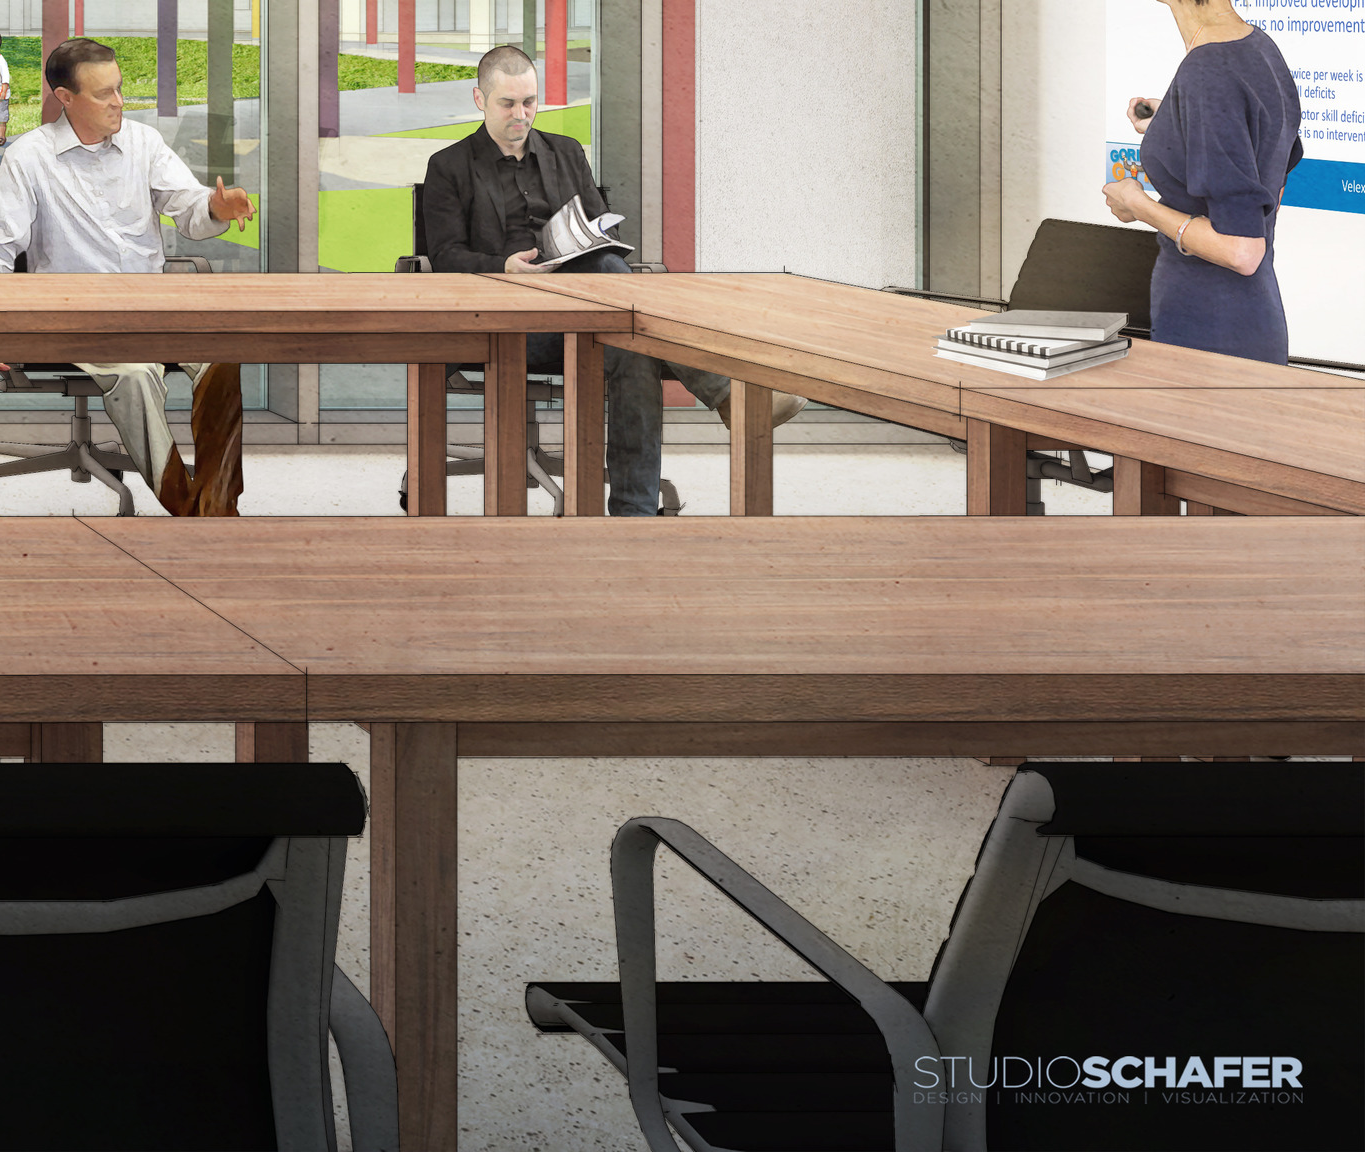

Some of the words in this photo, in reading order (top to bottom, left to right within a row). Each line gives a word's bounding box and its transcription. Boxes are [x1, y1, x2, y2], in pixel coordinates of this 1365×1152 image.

[1270, 19, 1284, 32] no
[1287, 16, 1365, 36] improvement
[1313, 71, 1328, 83] per
[1330, 69, 1354, 82] week
[1356, 69, 1364, 83] is
[1304, 85, 1336, 100] deficits
[1321, 109, 1338, 122] skill
[1304, 126, 1311, 139] is
[1313, 129, 1324, 140] no
